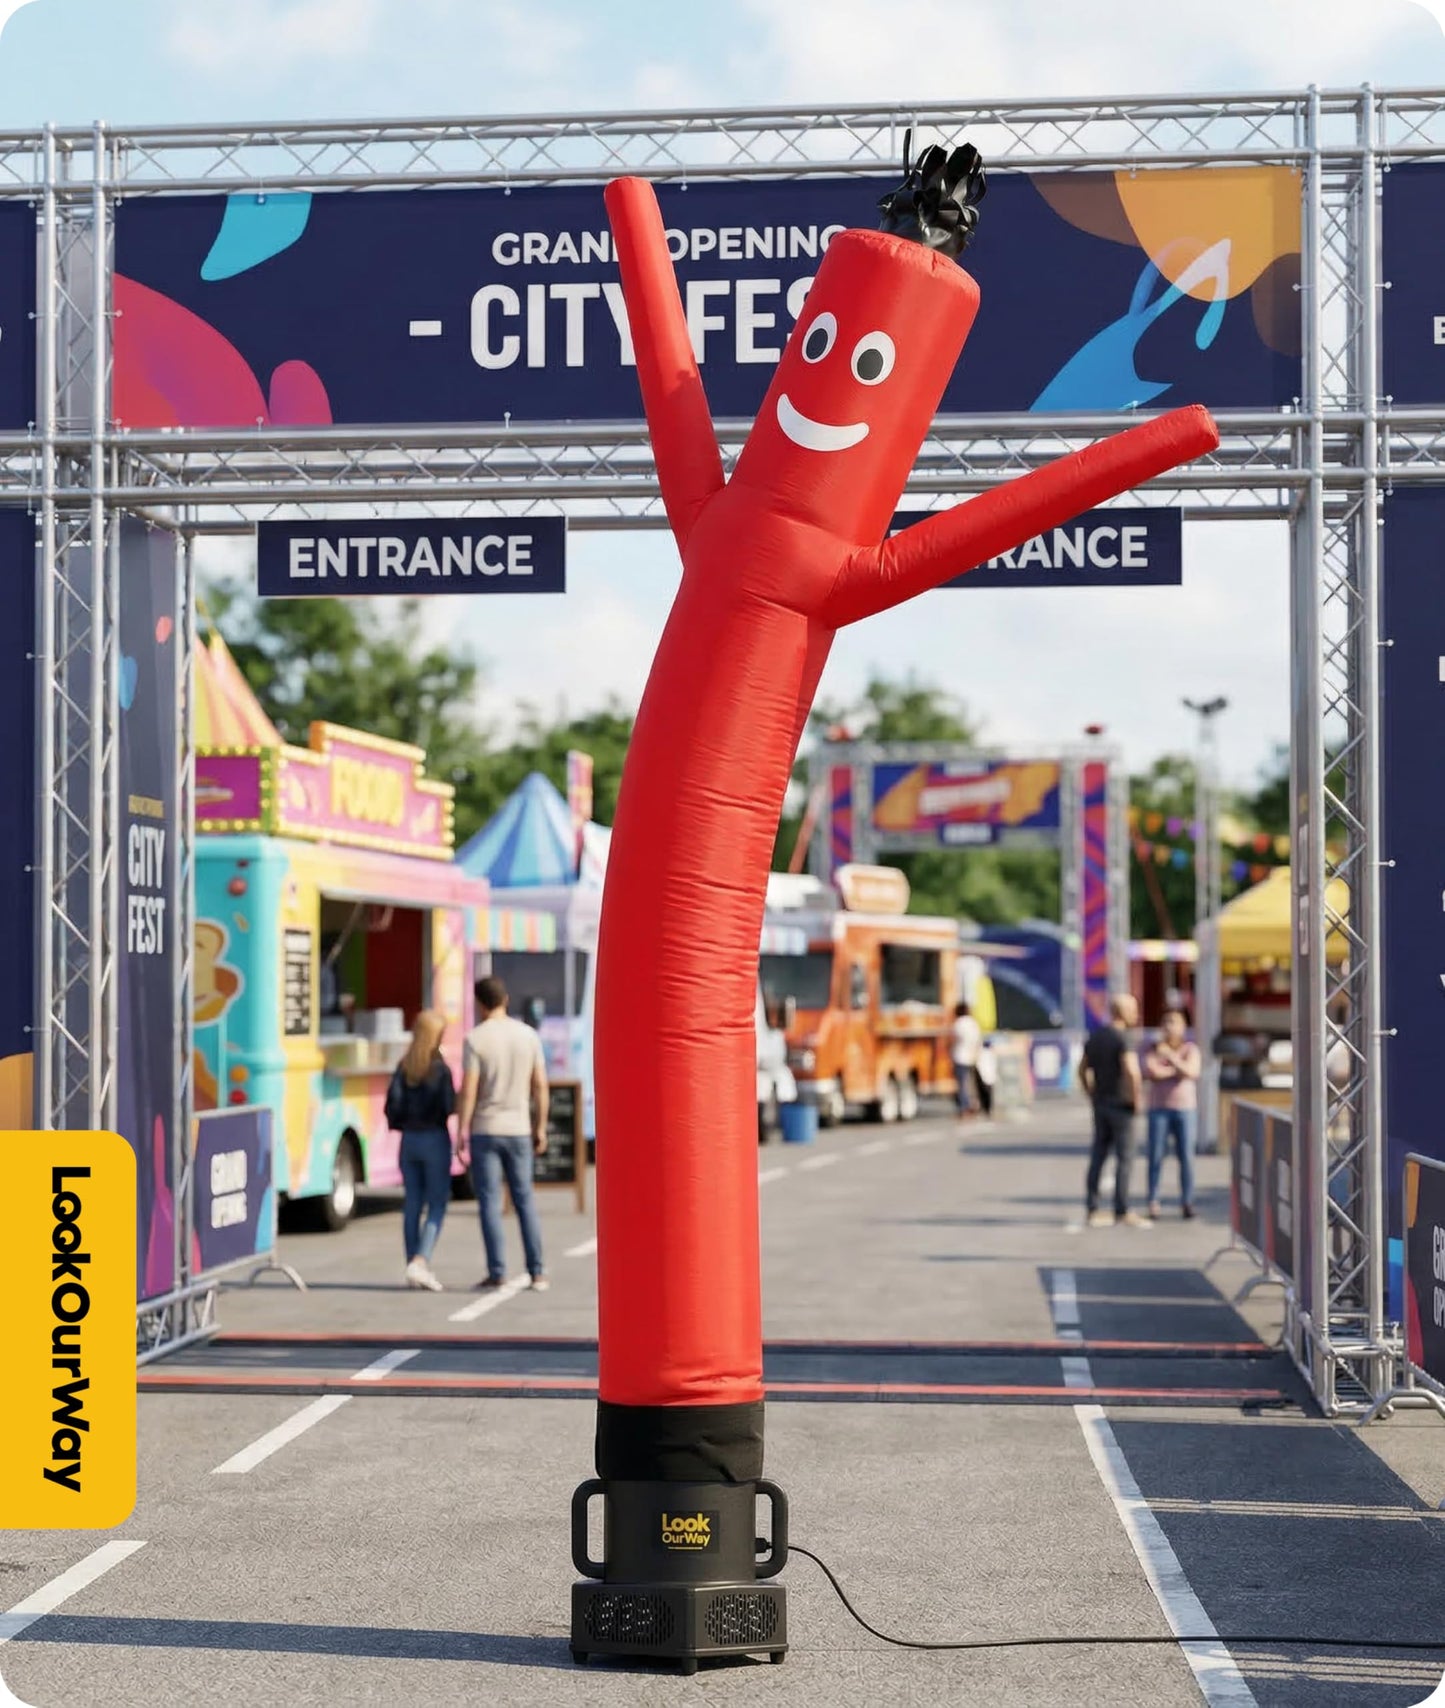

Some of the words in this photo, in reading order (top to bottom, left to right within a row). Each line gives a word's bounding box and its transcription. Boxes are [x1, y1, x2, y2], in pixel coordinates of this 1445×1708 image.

[492, 231, 620, 266] GRAN
[289, 535, 534, 578] ENTRANCE
[128, 823, 166, 889] CITY
[128, 894, 166, 955] FEST
[662, 1513, 711, 1532] Look
[662, 1532, 711, 1546] OurWay
